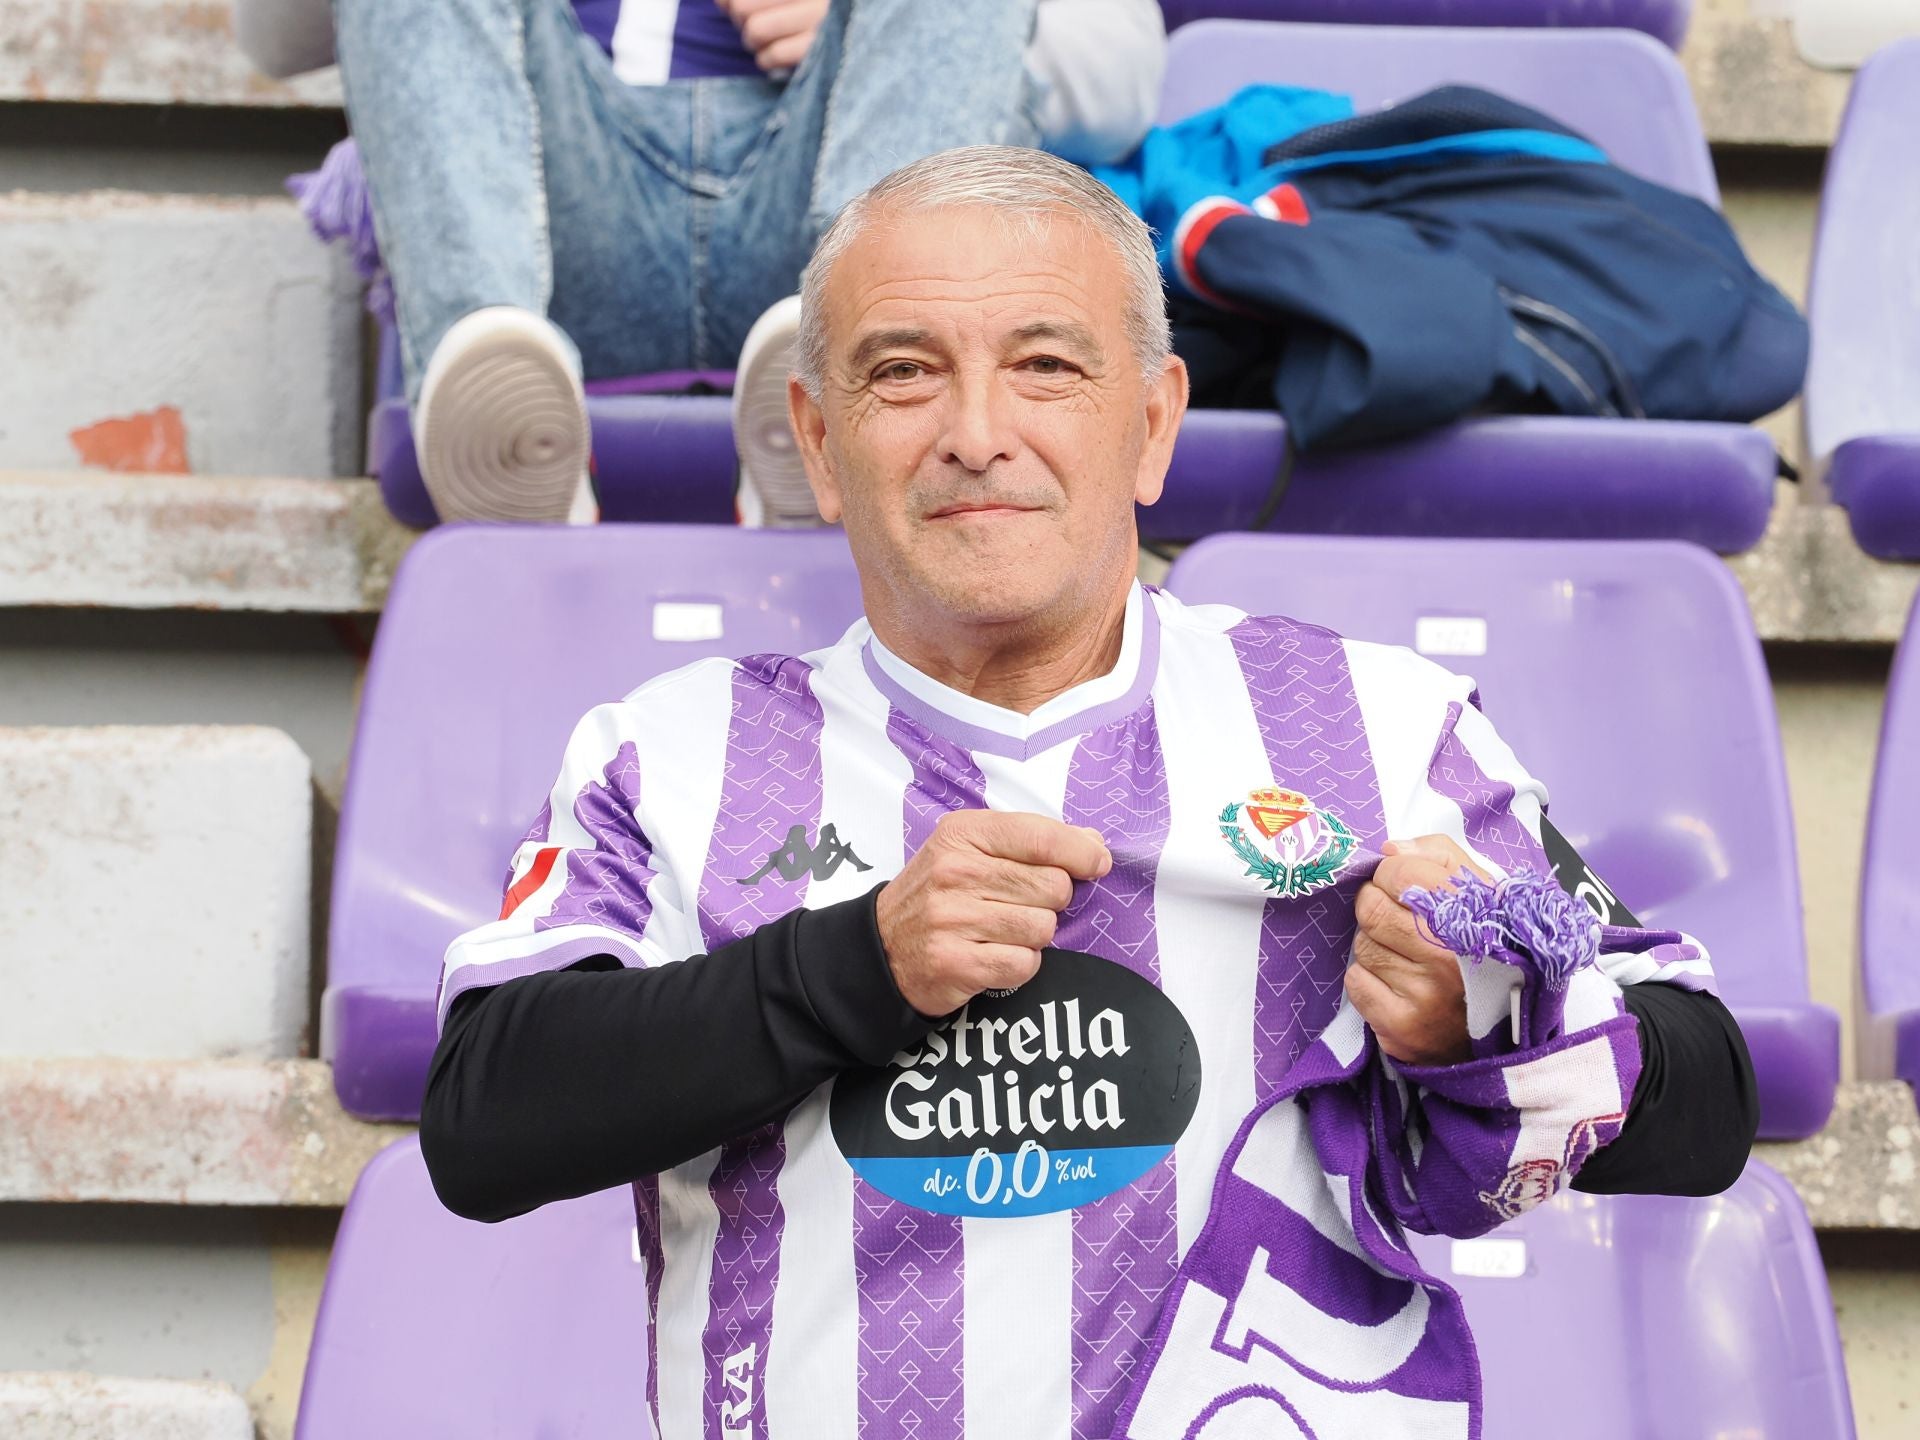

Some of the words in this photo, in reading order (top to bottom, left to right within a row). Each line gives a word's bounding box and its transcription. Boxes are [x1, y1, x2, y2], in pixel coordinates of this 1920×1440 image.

[884, 1065, 1126, 1141] Galicia
[923, 1168, 962, 1197] alc.
[966, 1140, 1050, 1205] 0,0
